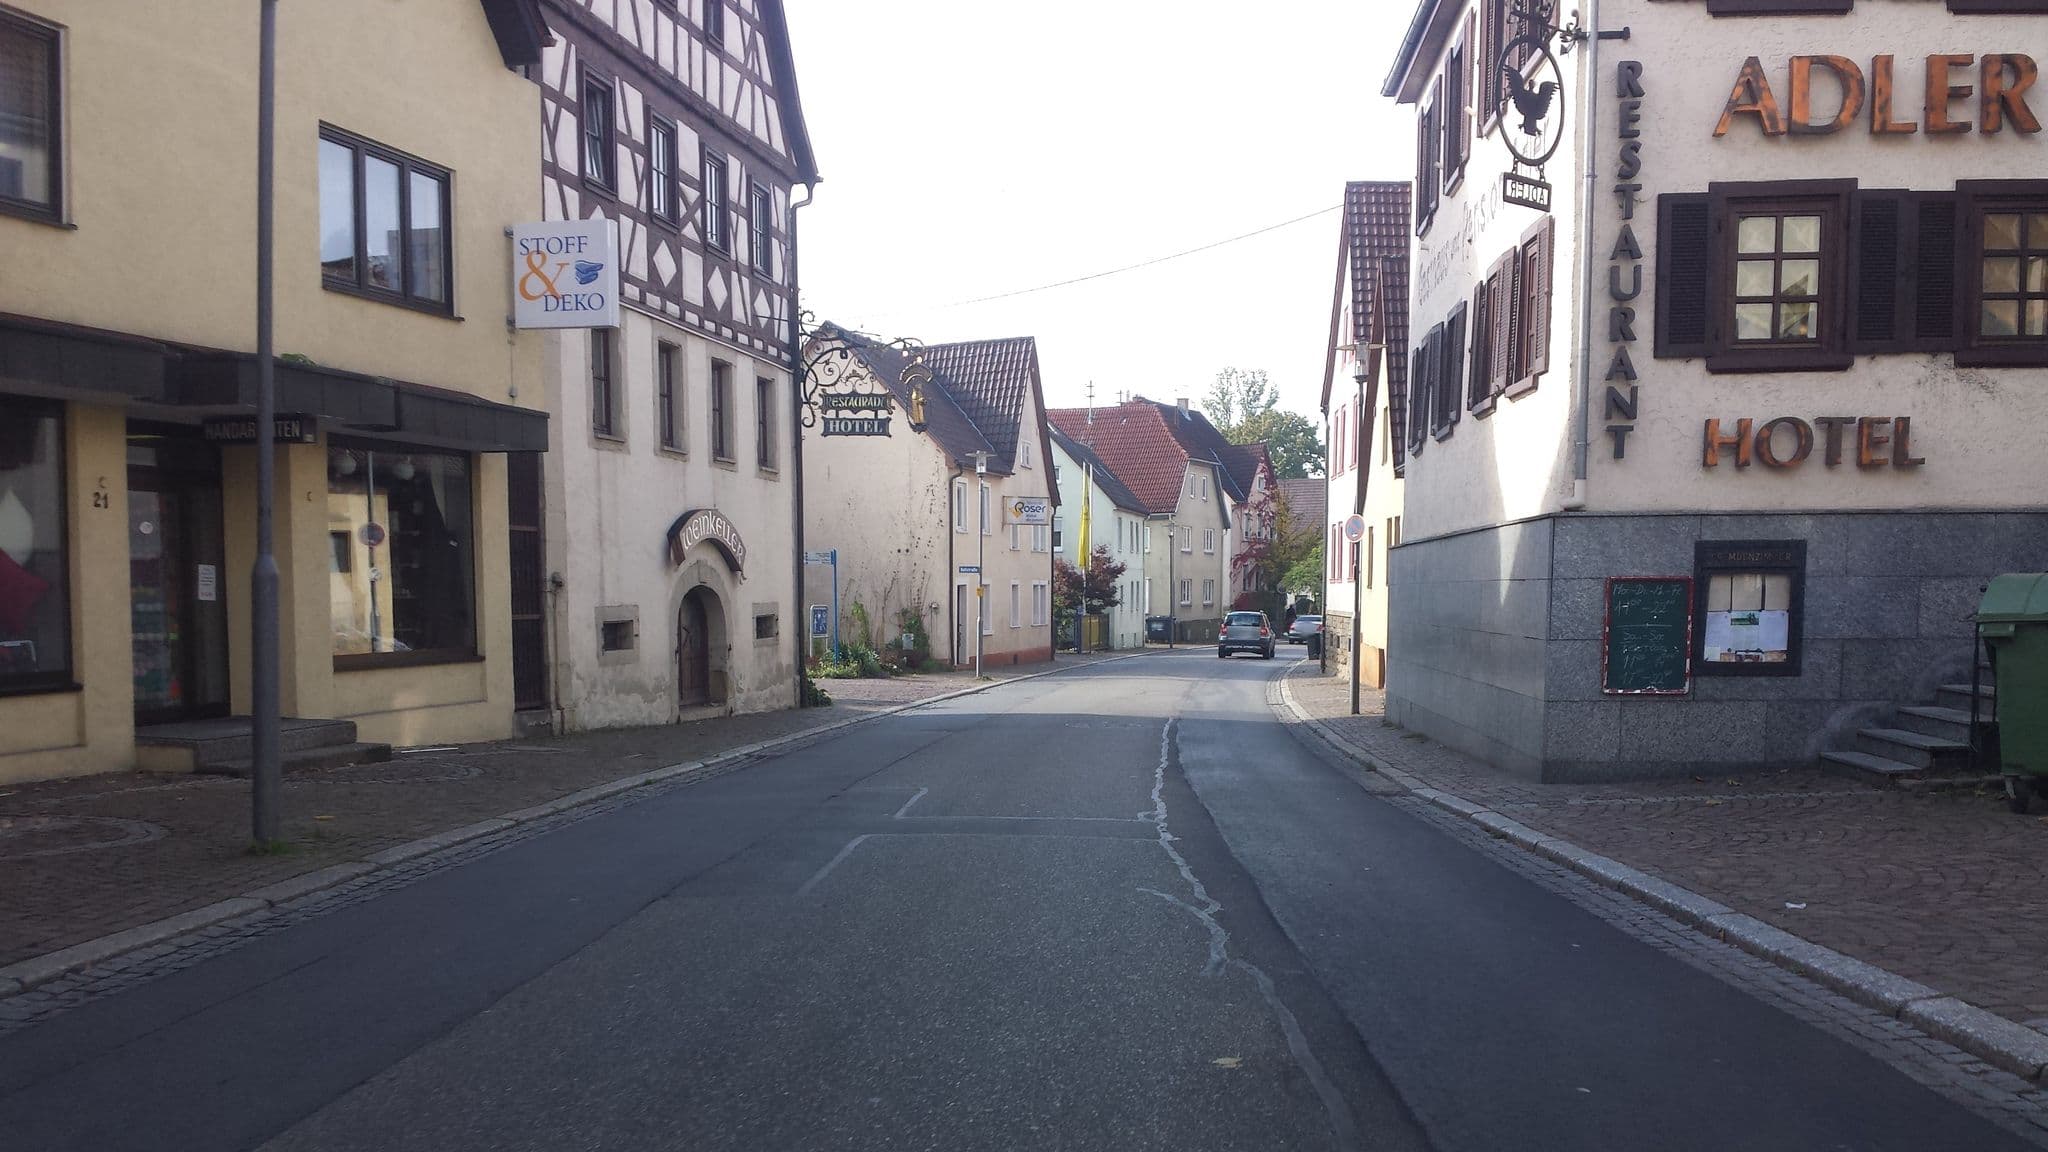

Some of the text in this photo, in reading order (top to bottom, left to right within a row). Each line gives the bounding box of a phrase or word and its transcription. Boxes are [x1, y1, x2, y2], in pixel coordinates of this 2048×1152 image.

[1711, 53, 2043, 138] ADLER
[519, 235, 588, 256] STOFF
[1605, 60, 1646, 460] RESTAURANT
[518, 250, 570, 301] &
[543, 292, 605, 312] DEKO
[206, 419, 300, 440] HANDARTEN
[829, 420, 883, 433] HOTEL
[1702, 416, 1926, 468] HOTEL
[93, 491, 109, 509] 21
[1015, 502, 1046, 513] Roser
